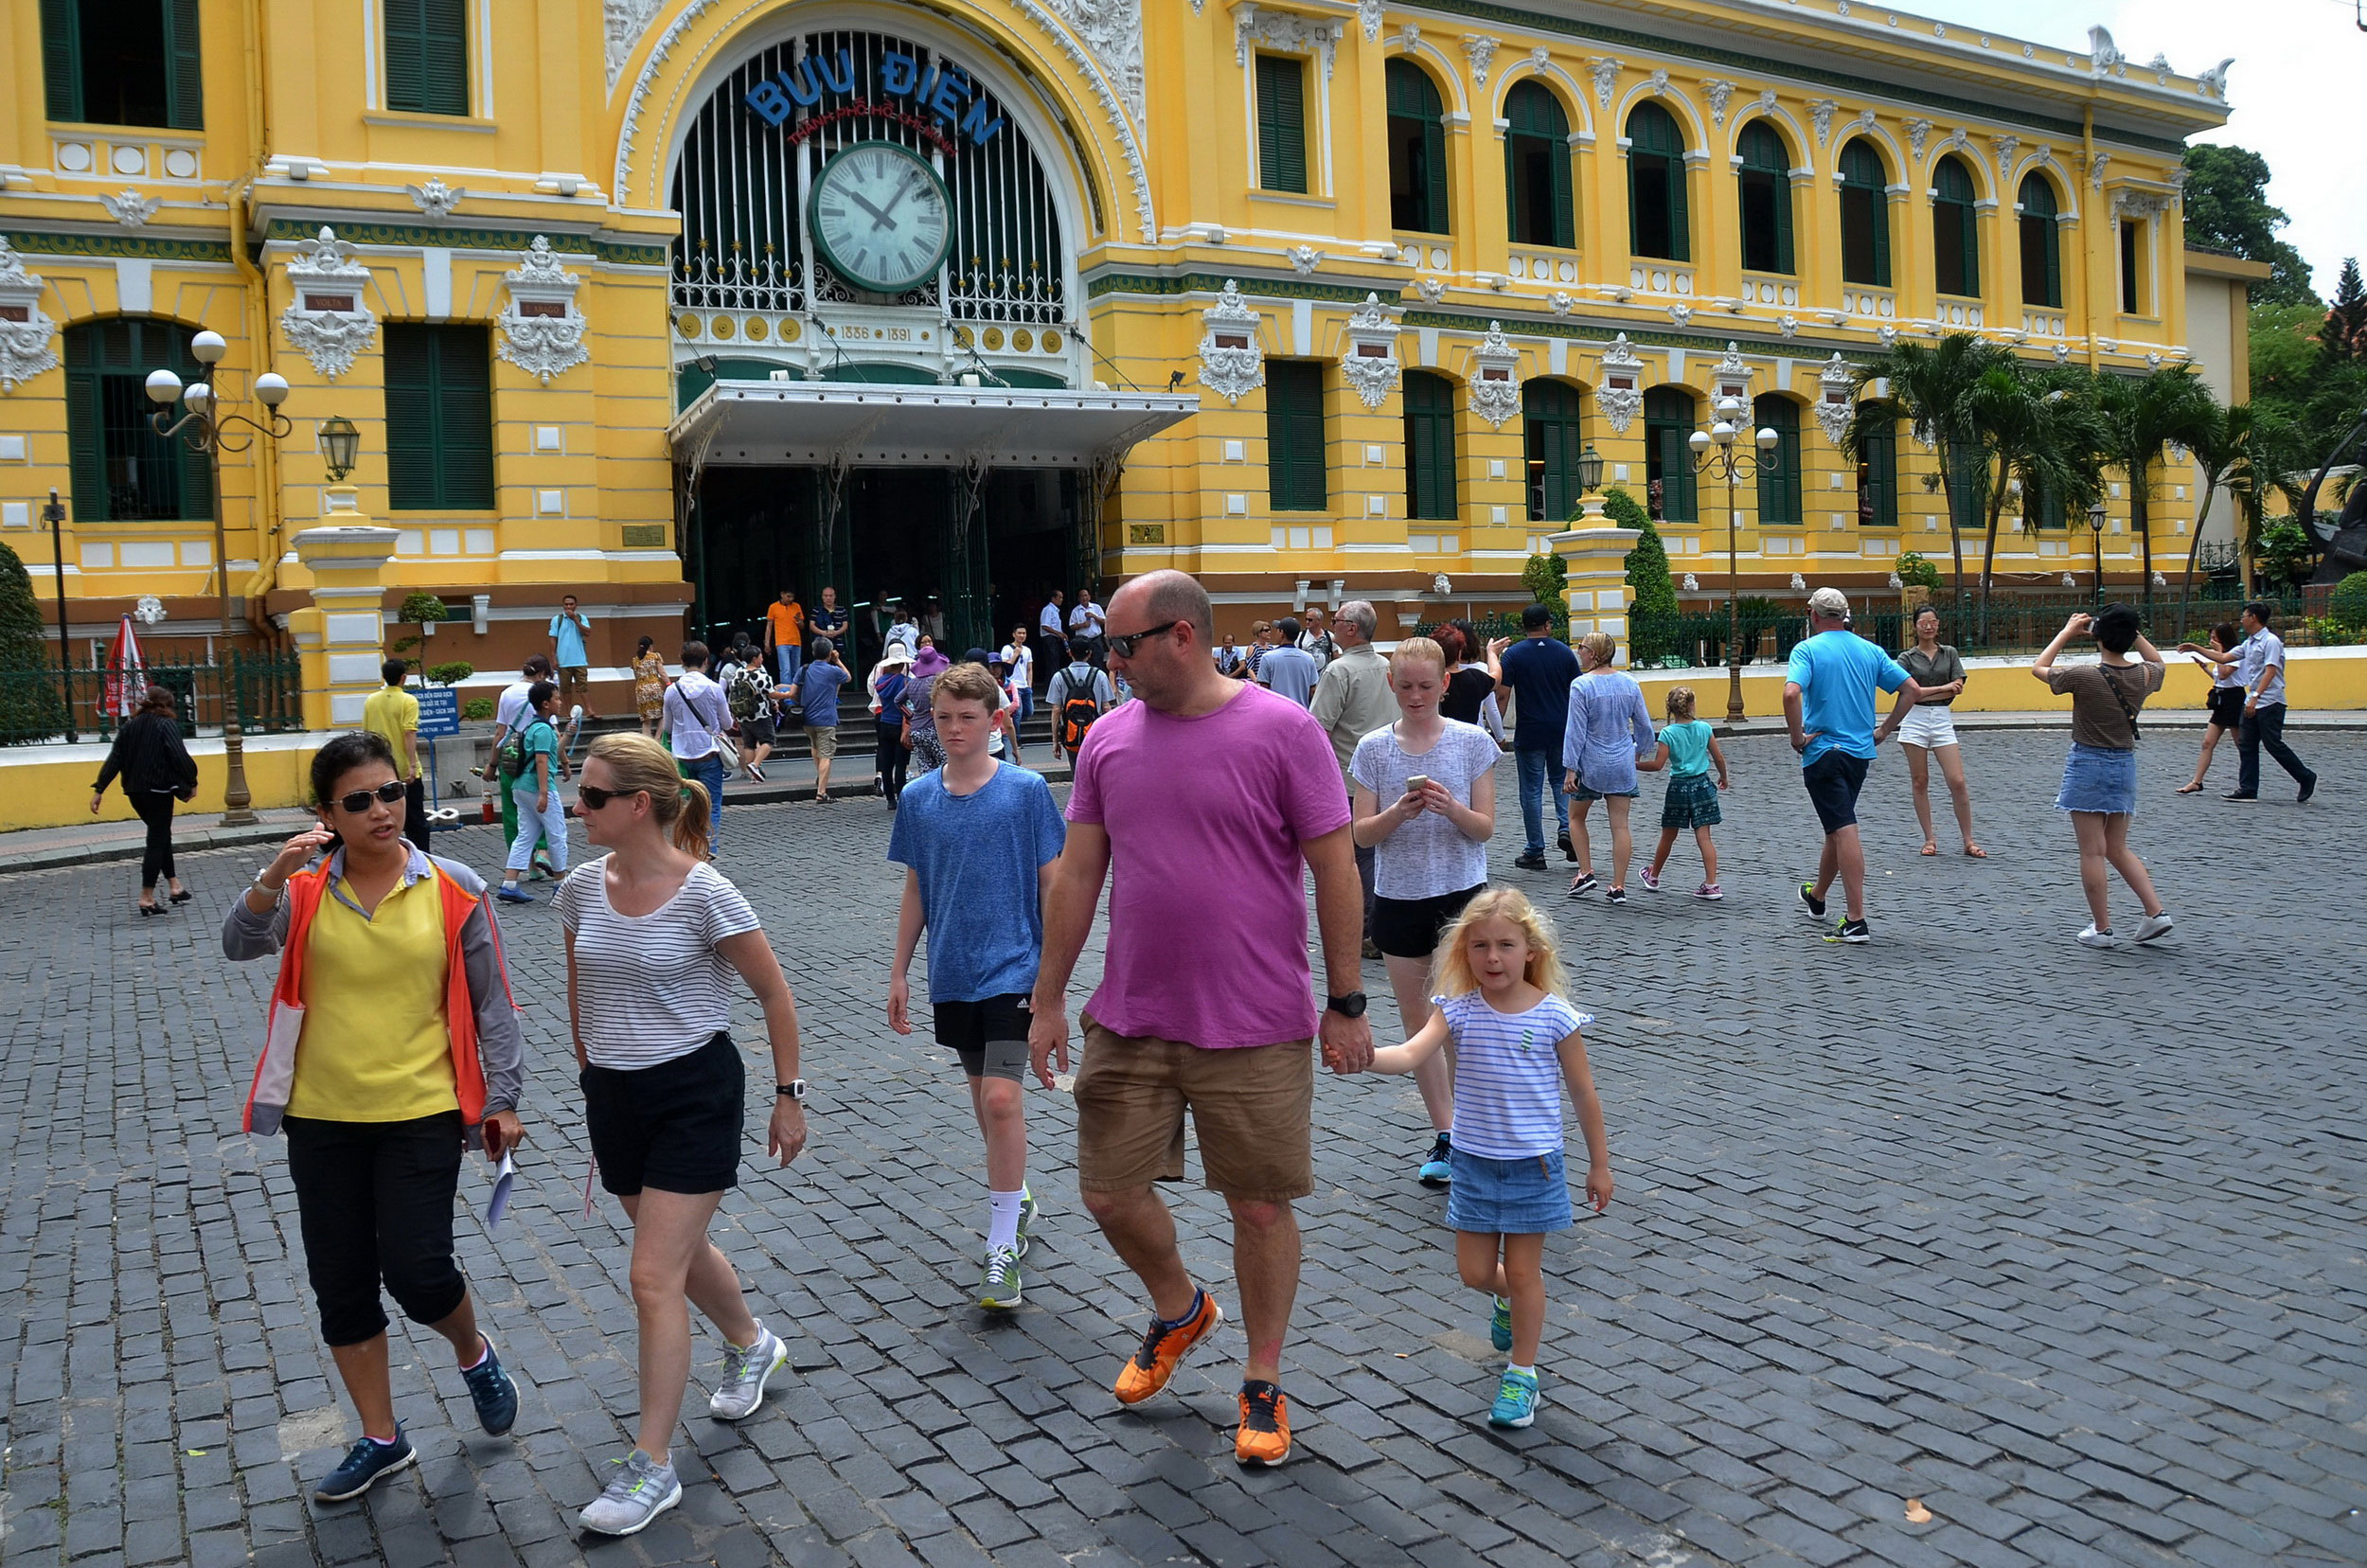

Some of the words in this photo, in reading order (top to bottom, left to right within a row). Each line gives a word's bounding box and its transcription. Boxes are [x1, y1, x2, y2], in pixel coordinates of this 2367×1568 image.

[745, 48, 854, 127] BƯU
[881, 50, 1005, 146] ĐIỆN
[836, 96, 866, 119] PHỐ
[869, 98, 895, 118] HỒ
[897, 113, 928, 130] CHÍ
[924, 125, 957, 157] MINH
[841, 326, 869, 339] 1886
[887, 328, 911, 341] 1891
